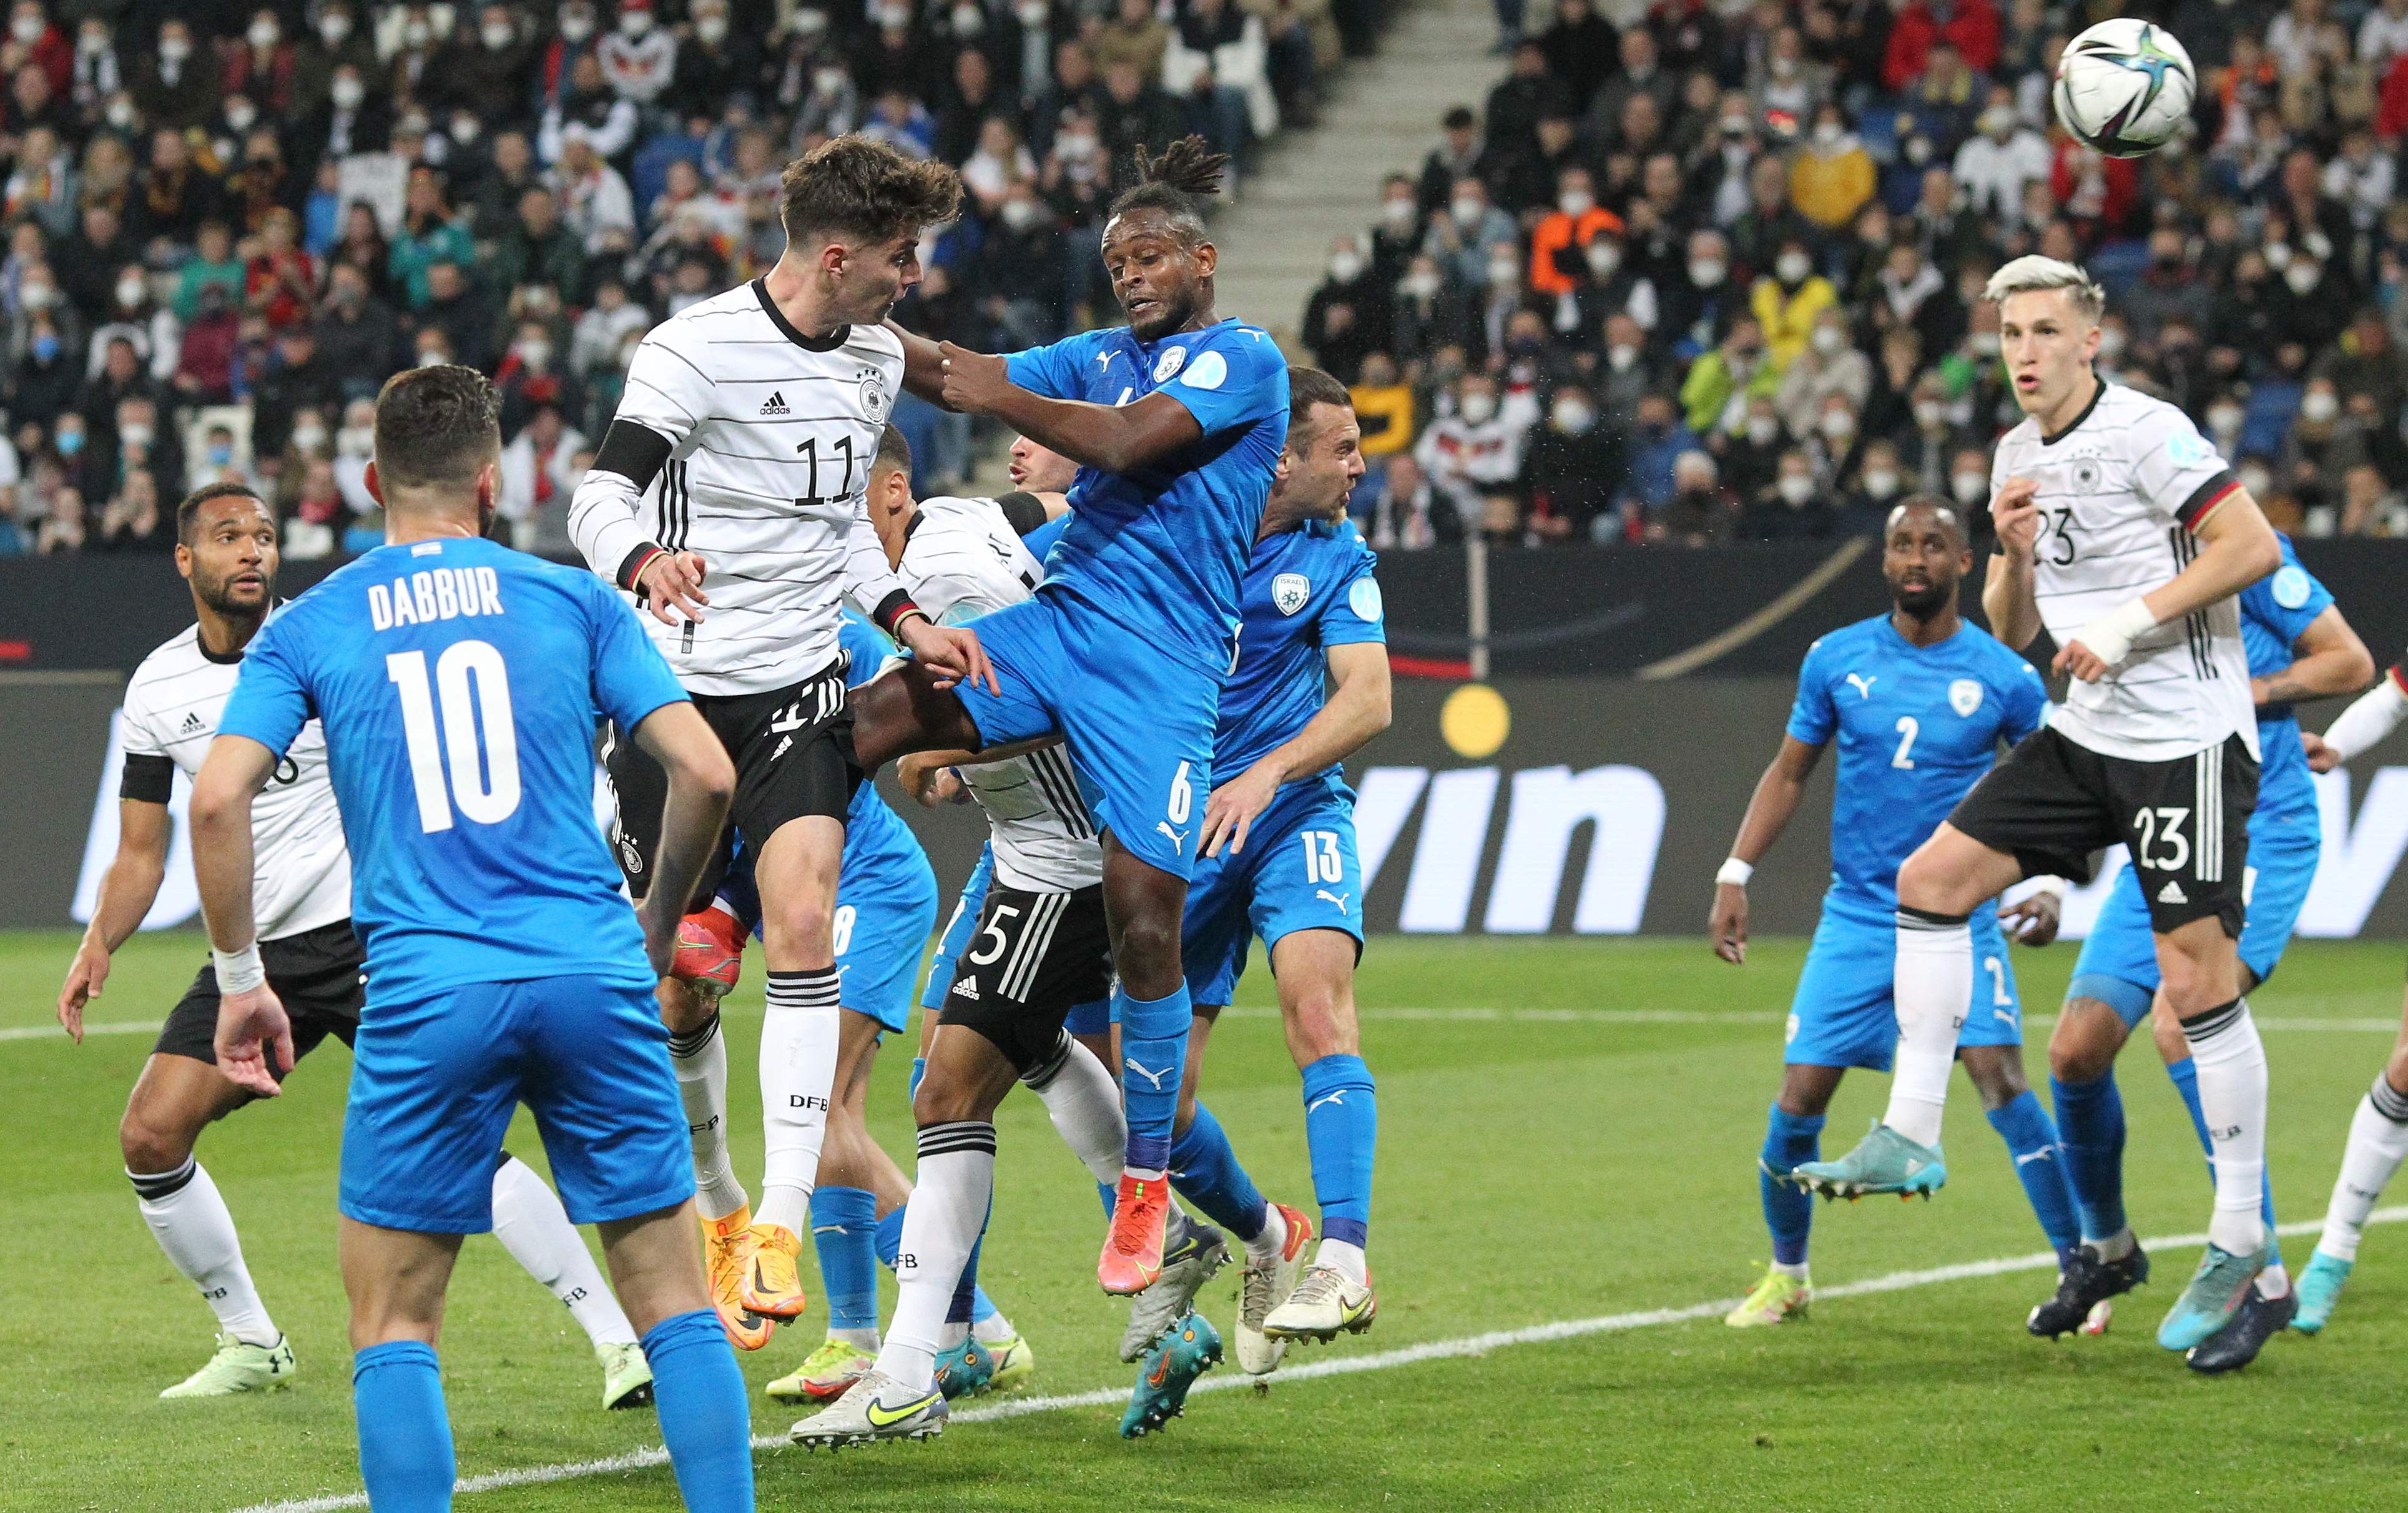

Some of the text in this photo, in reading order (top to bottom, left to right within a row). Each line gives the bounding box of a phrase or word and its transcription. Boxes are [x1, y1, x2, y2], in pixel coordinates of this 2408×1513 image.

[760, 407, 790, 415] adidas
[795, 435, 852, 506] 11
[367, 566, 504, 631] DABBUR
[385, 639, 521, 834] 10
[1891, 716, 1919, 770] 2
[1167, 760, 1192, 825] 6
[1300, 831, 1342, 884] 13
[2133, 806, 2191, 871] 23
[969, 904, 1020, 965] 5
[952, 986, 980, 1000] adidas
[1984, 956, 2012, 1005] 2
[790, 1094, 828, 1111] DFB
